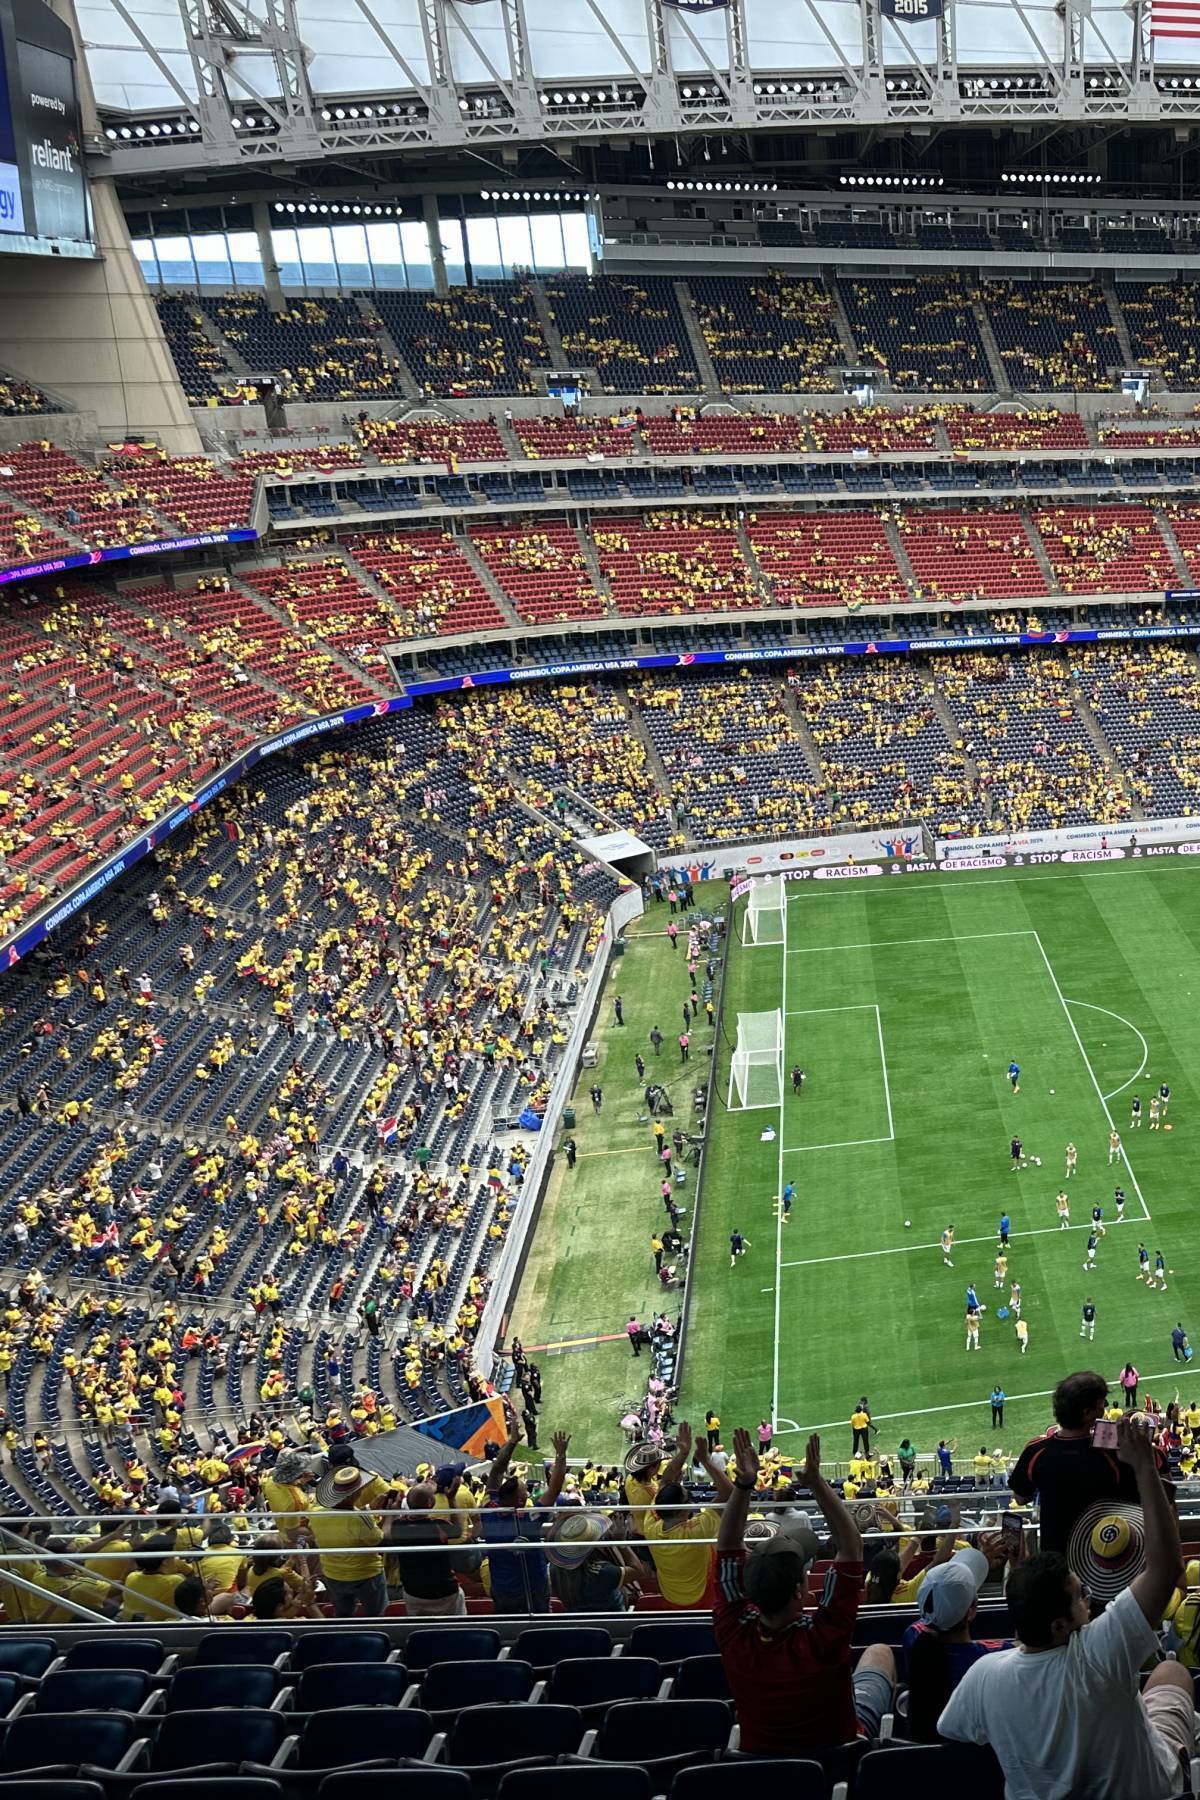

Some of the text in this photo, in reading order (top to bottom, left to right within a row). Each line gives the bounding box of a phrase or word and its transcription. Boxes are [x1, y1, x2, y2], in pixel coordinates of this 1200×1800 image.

[895, 0, 928, 15] 2015
[31, 93, 66, 116] powered by
[31, 139, 74, 173] reliant
[1133, 630, 1149, 638] COPA
[946, 640, 963, 648] COPA
[963, 638, 991, 646] AMERICA
[725, 652, 763, 660] CONMEBOL
[764, 650, 782, 658] COPA
[783, 648, 813, 657] AMERICA
[510, 668, 550, 679] CONMEBOL
[551, 665, 570, 675] COPA
[570, 662, 604, 672] AMERICA
[605, 661, 619, 669] USA
[1030, 851, 1112, 864] STOP RACISM
[1147, 847, 1175, 855] BASTA
[906, 857, 1002, 871] BASTA DE RACISMO
[780, 867, 868, 880] STOP RACISM
[45, 877, 106, 931] CONMEBOL COPA AMERICA
